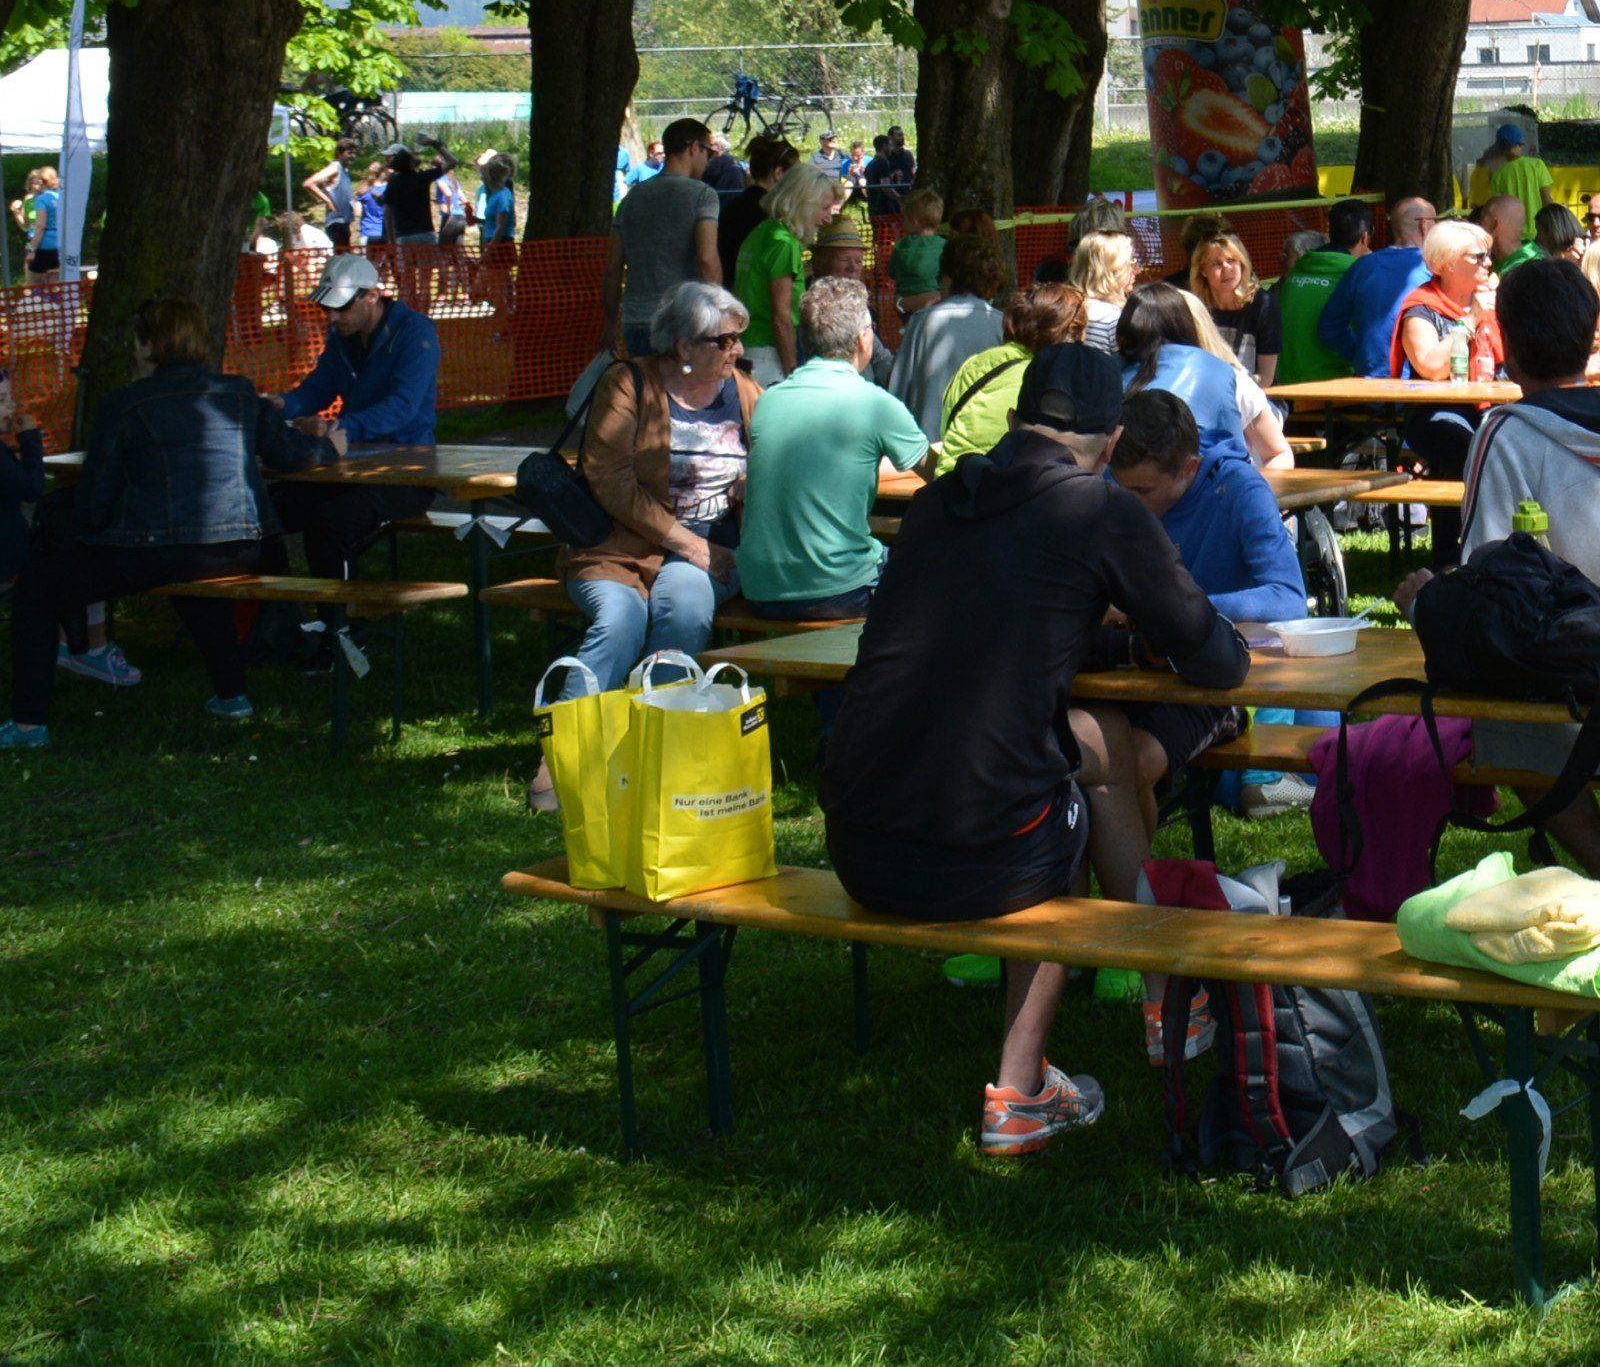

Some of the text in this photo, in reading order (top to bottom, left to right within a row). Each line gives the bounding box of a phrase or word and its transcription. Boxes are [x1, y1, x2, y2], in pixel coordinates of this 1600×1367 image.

[674, 790, 749, 806] Nur eine Bank
[700, 808, 715, 817] ist
[717, 802, 747, 815] meine
